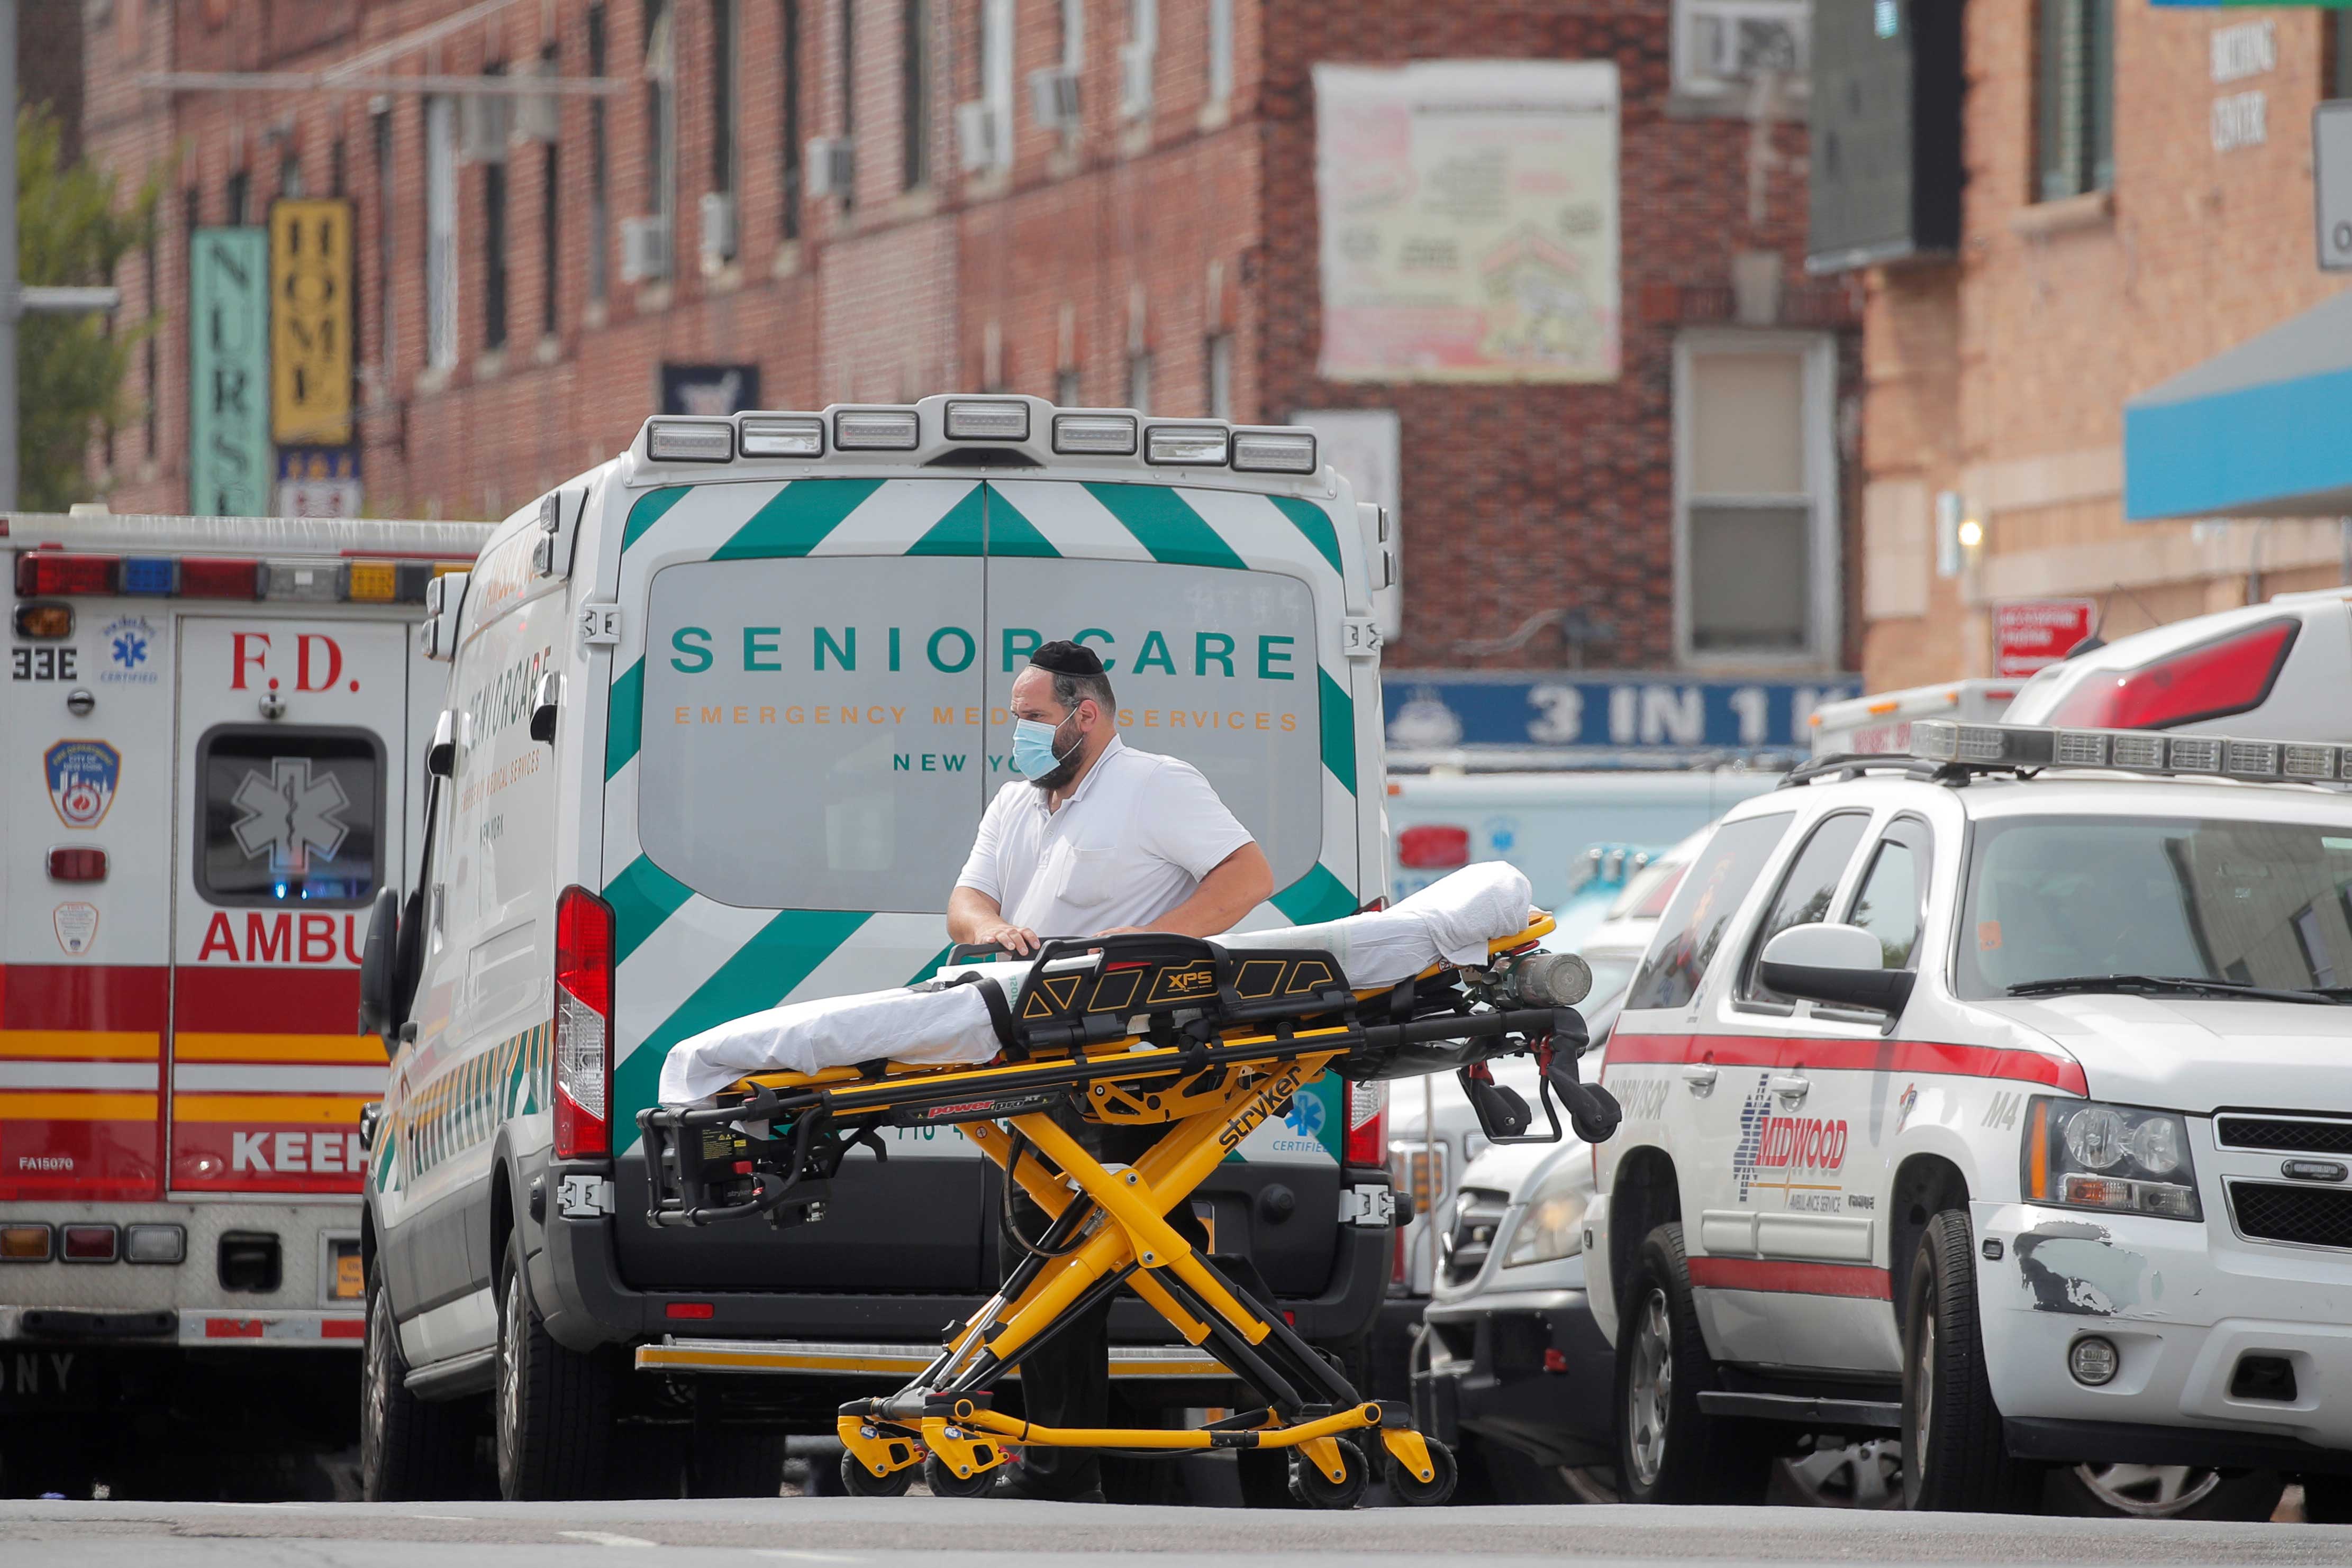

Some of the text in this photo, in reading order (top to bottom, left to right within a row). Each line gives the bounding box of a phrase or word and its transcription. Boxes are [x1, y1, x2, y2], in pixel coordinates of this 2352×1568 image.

[230, 632, 360, 692] F.D.
[675, 706, 906, 725] EMERGENCY
[1117, 709, 1296, 731] SERVICES
[1527, 683, 1584, 743] 3
[1609, 685, 1704, 745] IN
[1730, 687, 1768, 746] 1
[510, 748, 540, 785] SERVICES
[894, 754, 966, 772] NEW
[1168, 971, 1212, 989] XPS
[927, 1100, 995, 1119] power
[1219, 1066, 1302, 1154] stryker
[1981, 1091, 2021, 1131] M4
[1755, 1116, 1848, 1170] MIDWOOD
[19, 1156, 73, 1170] FA15070
[0, 1352, 75, 1395] NY
